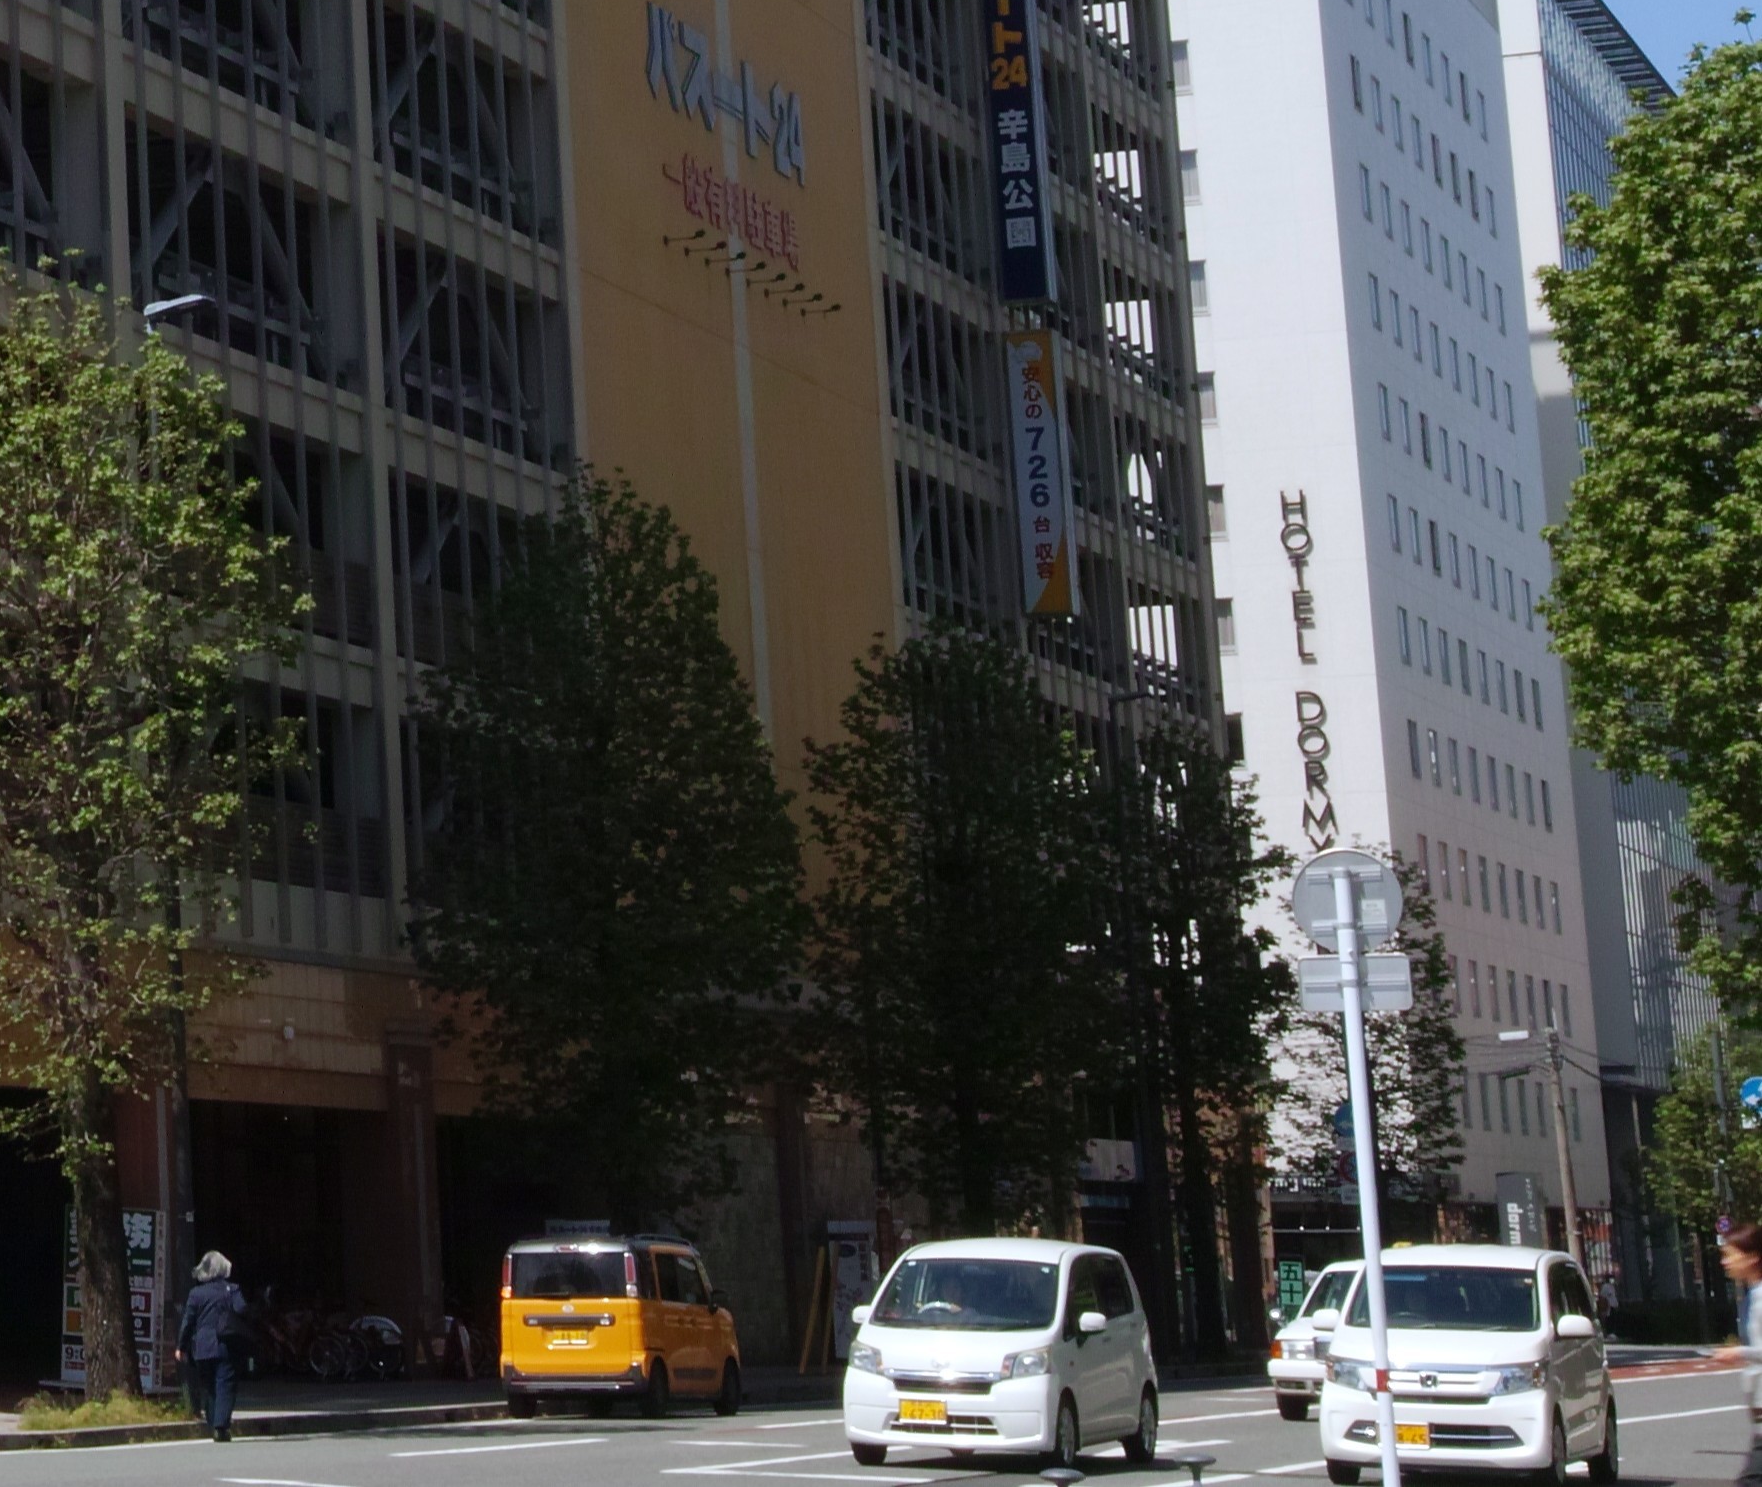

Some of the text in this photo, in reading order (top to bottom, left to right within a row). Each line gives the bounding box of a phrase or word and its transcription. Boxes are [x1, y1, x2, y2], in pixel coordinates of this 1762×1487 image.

[646, 0, 806, 189] パスート24
[997, 108, 1037, 250] 辛島公園
[1279, 489, 1319, 666] HOTEL
